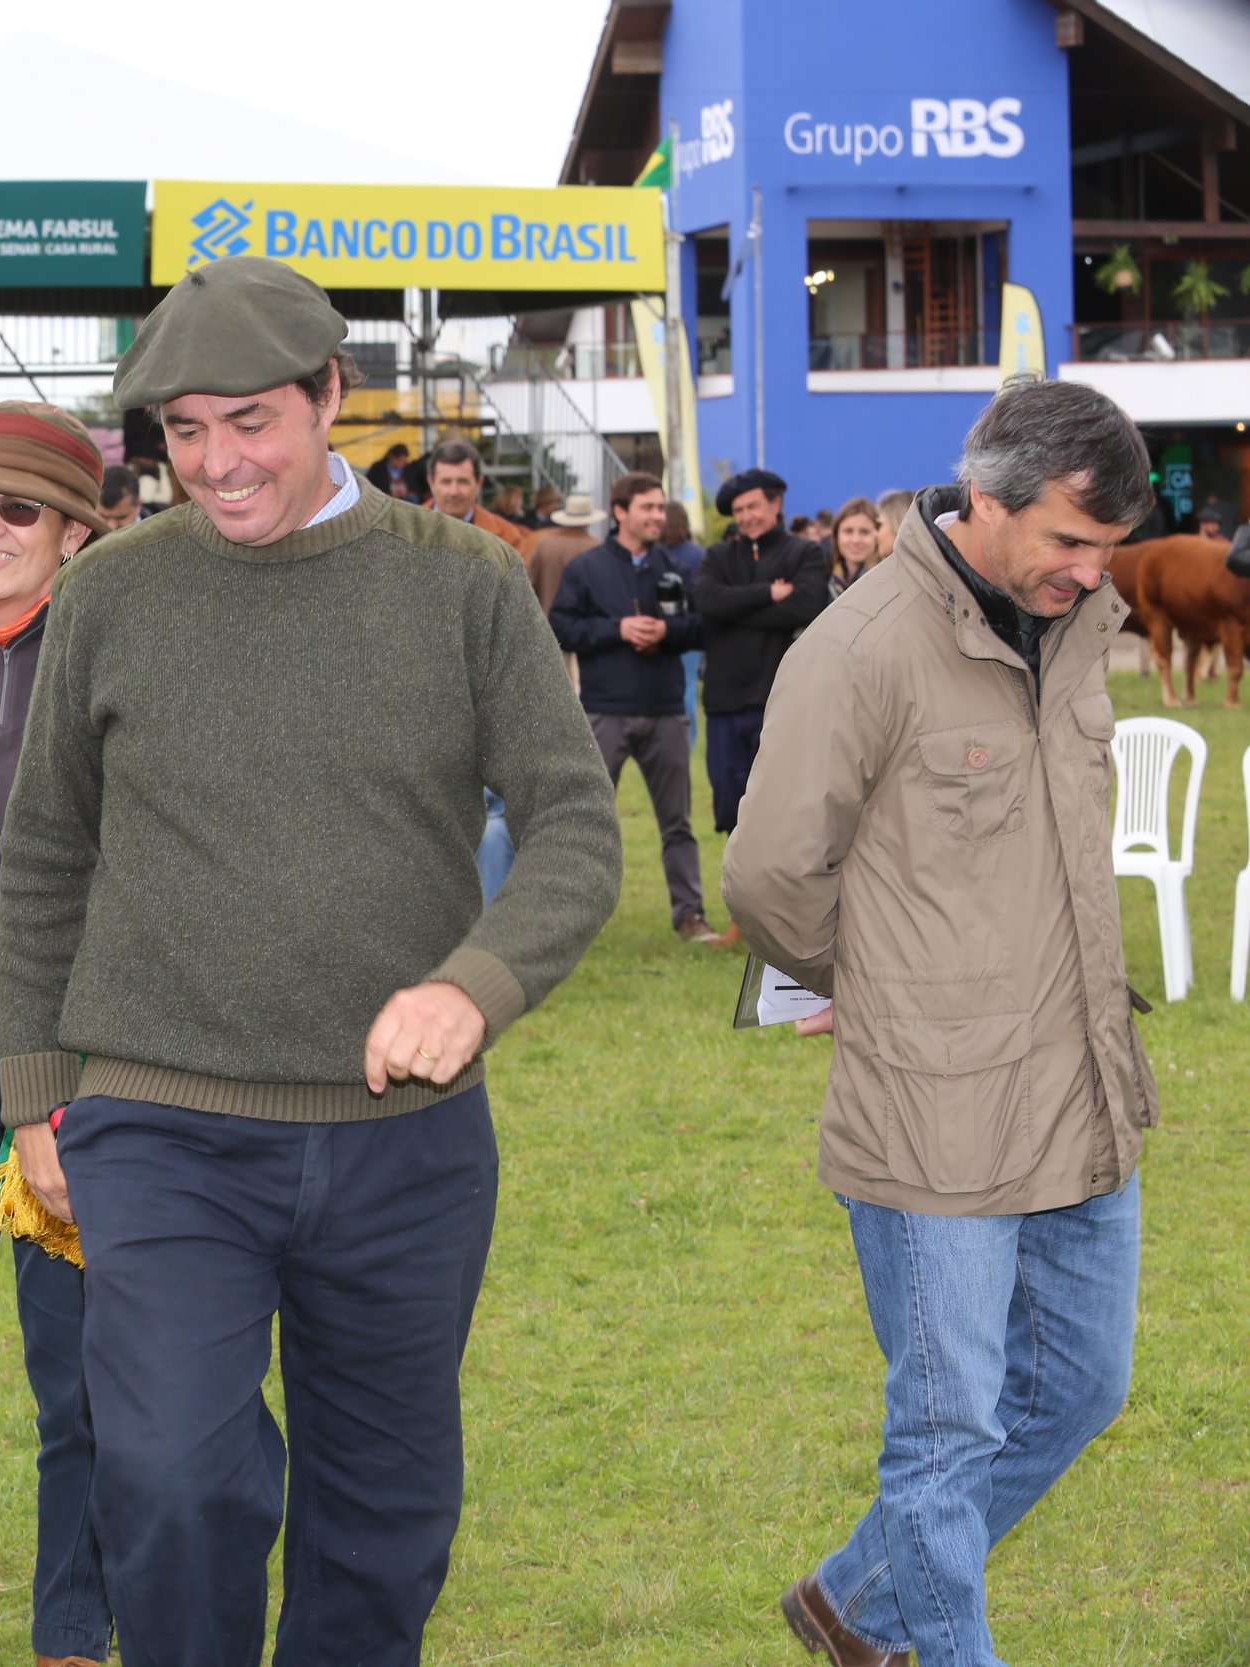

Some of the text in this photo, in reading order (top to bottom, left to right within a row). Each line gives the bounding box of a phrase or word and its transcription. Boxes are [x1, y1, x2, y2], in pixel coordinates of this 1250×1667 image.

[784, 97, 1025, 165] Grupo RBS
[41, 218, 119, 239] FARSUL
[265, 209, 638, 261] BANCO DO BRASIL
